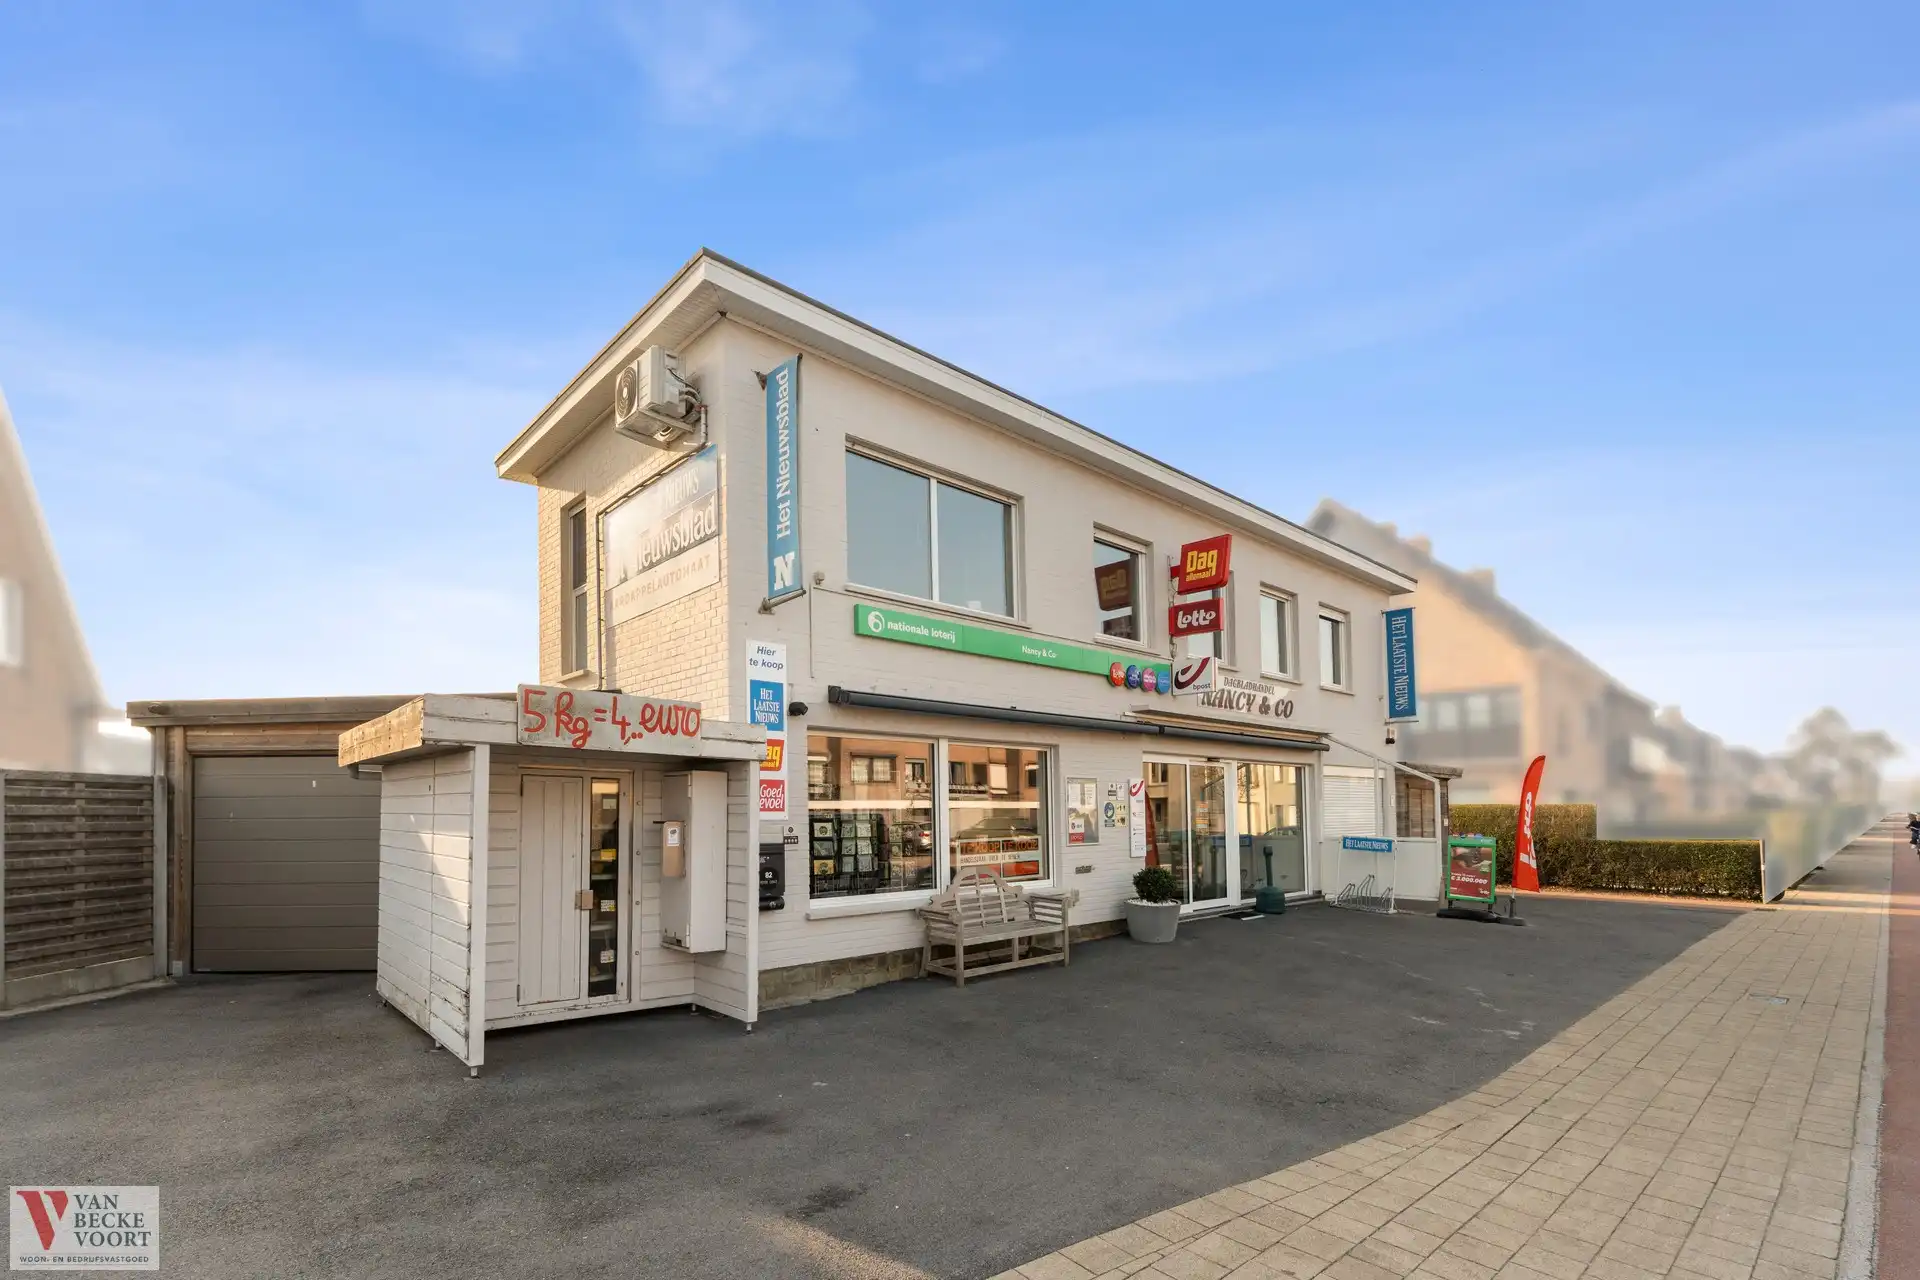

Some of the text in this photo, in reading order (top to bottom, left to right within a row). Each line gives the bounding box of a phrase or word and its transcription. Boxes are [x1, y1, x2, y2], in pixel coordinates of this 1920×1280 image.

[775, 367, 791, 540] Het Nieuwsblad
[1391, 615, 1406, 634] HET
[887, 621, 956, 644] nationale loterij
[756, 645, 776, 656] Hier
[1022, 645, 1042, 659] Nancy
[749, 657, 784, 671] te koop
[1192, 682, 1211, 690] bpost
[1394, 675, 1409, 710] NIEUWS
[760, 688, 773, 700] HET
[753, 698, 780, 713] LAATSTE
[1201, 688, 1294, 718] NANCY & CO
[523, 688, 547, 733] 5
[639, 702, 700, 738] euro
[755, 710, 779, 724] NIEUWS
[760, 784, 783, 798] Goed
